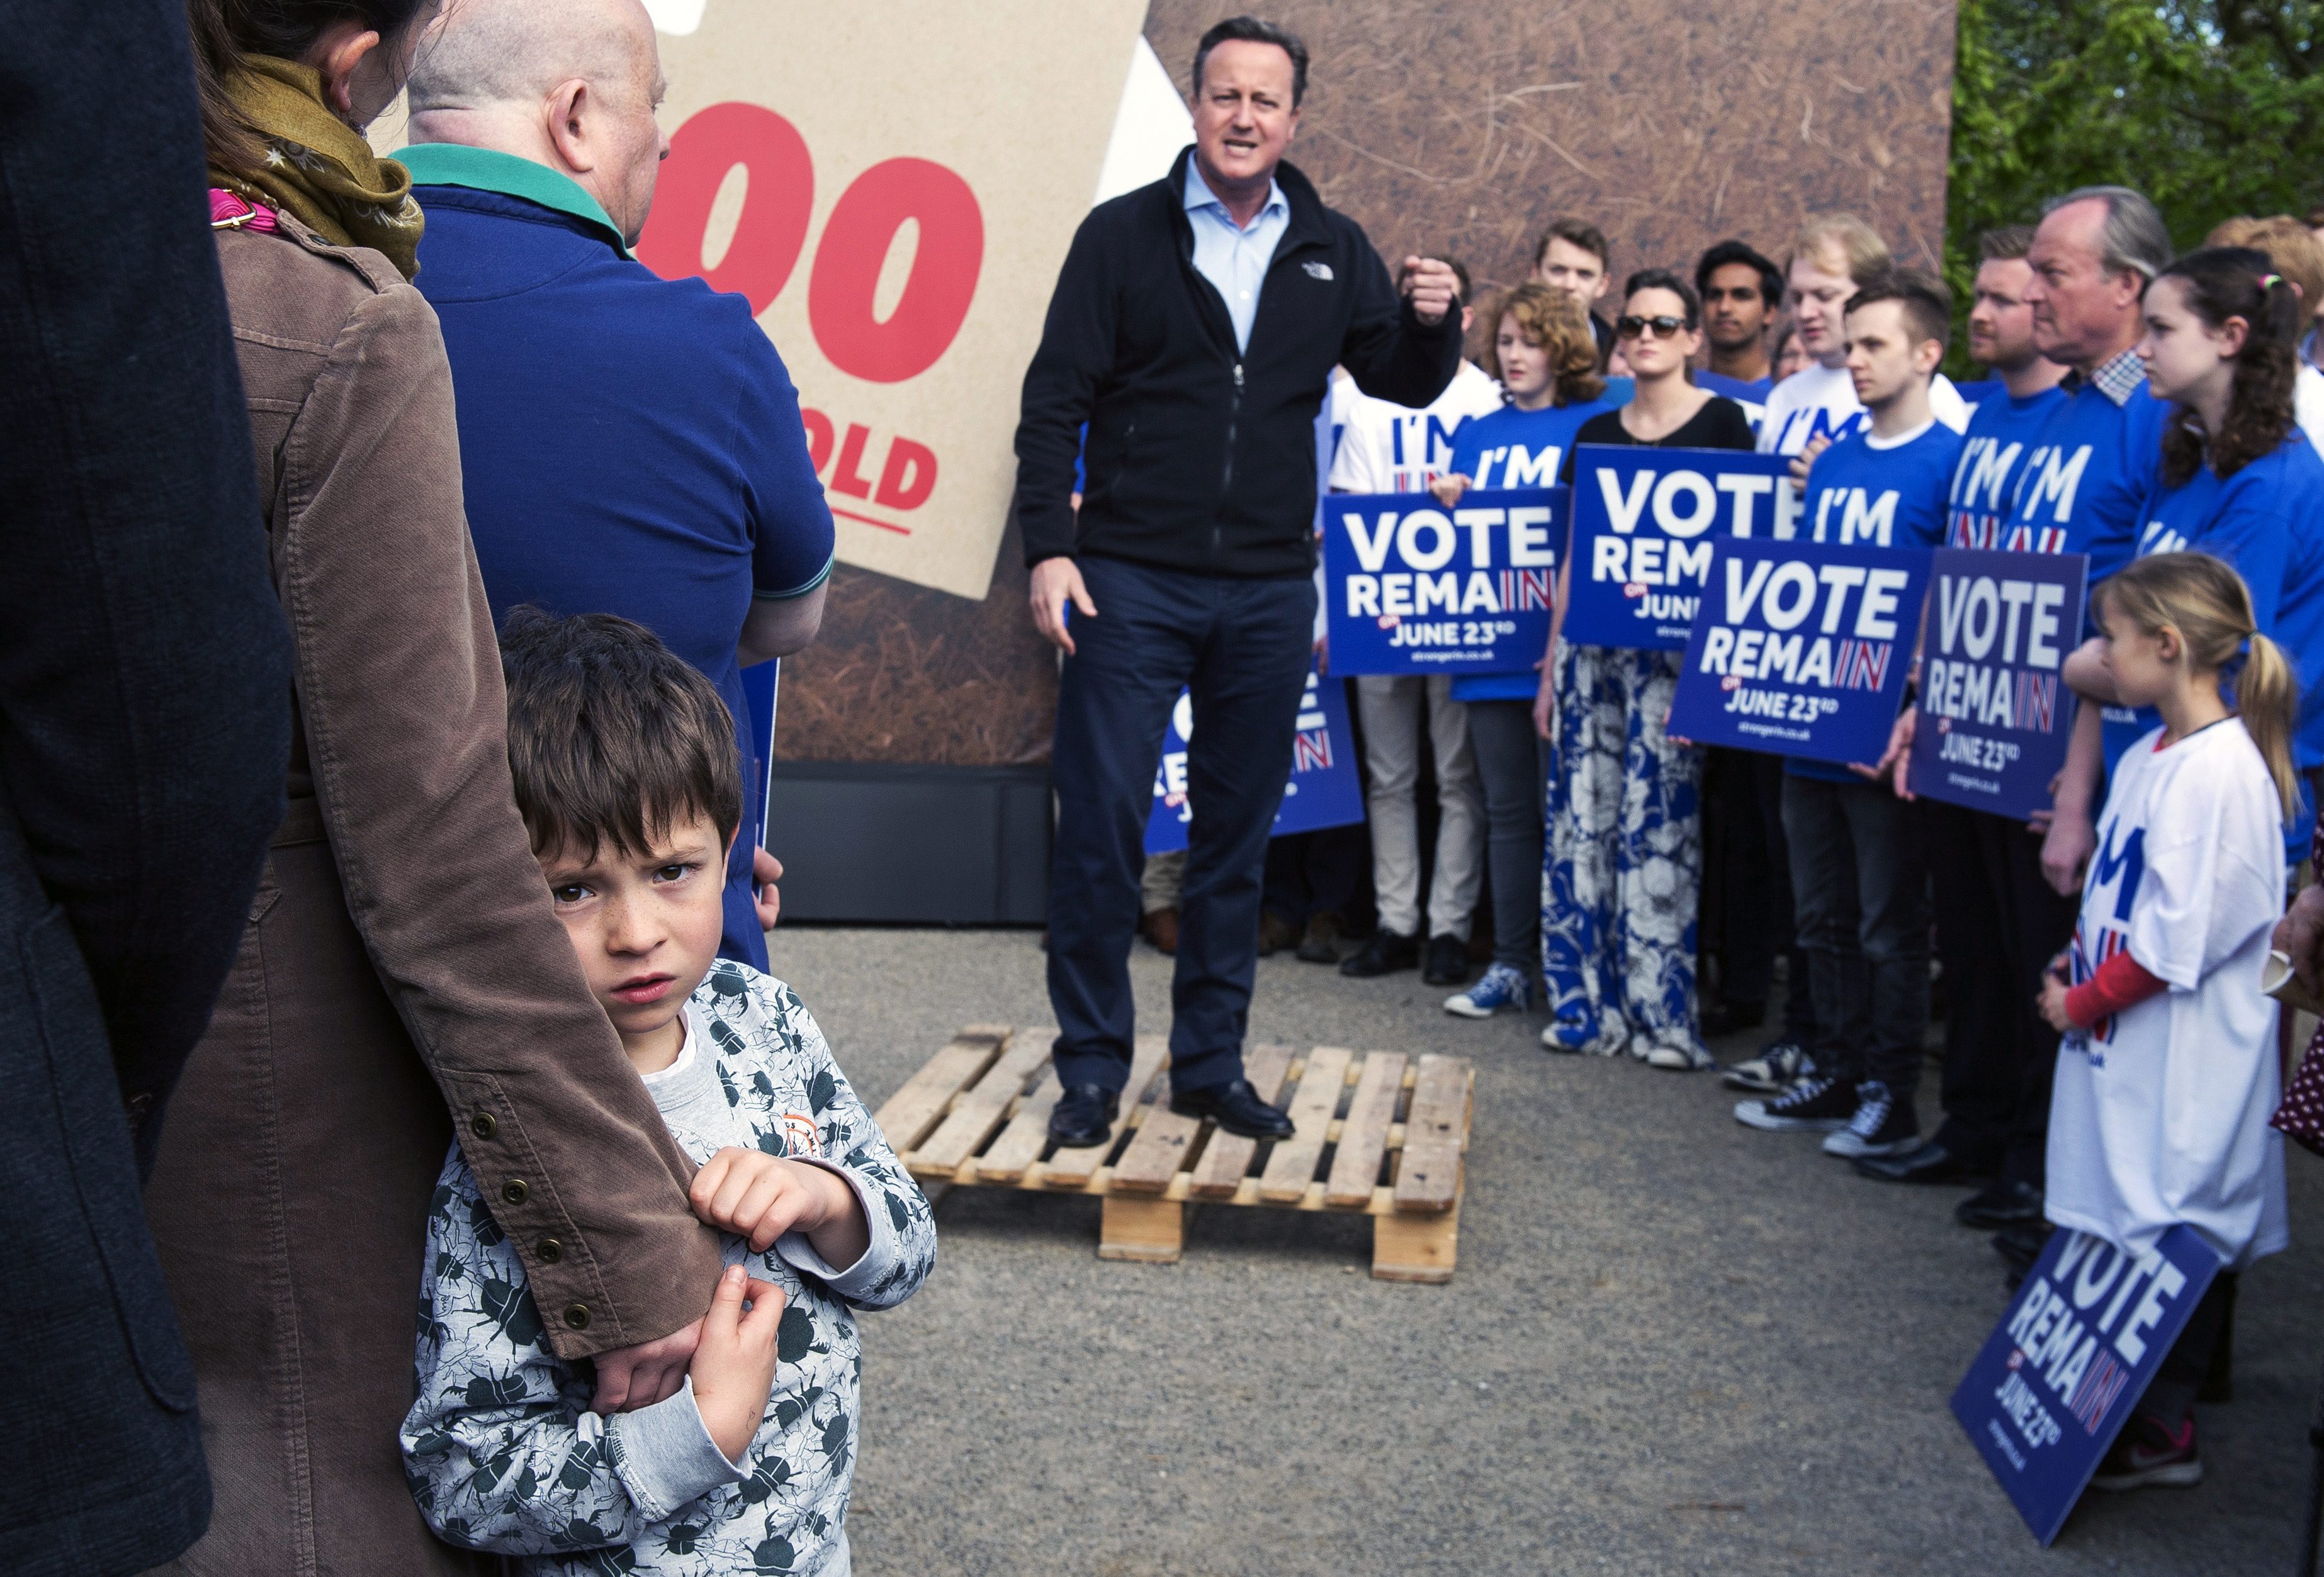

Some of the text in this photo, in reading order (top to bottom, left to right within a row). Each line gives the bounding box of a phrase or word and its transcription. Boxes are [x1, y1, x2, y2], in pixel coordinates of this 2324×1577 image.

[1473, 444, 1562, 490] I'M
[1342, 506, 1555, 572] VOTE
[1814, 486, 1900, 547] I'M
[1593, 535, 1714, 586] REM
[1346, 569, 1557, 617] REMAIN
[1724, 557, 1909, 641] VOTE
[1939, 573, 2065, 670] VOTE
[1389, 622, 1460, 648] JUNE
[1700, 626, 1893, 693] REMAIN
[1724, 688, 1790, 719] JUNE
[1925, 658, 2058, 735] REMAIN
[1939, 731, 1983, 768] JUNE
[2005, 1276, 2131, 1437] REMAIN
